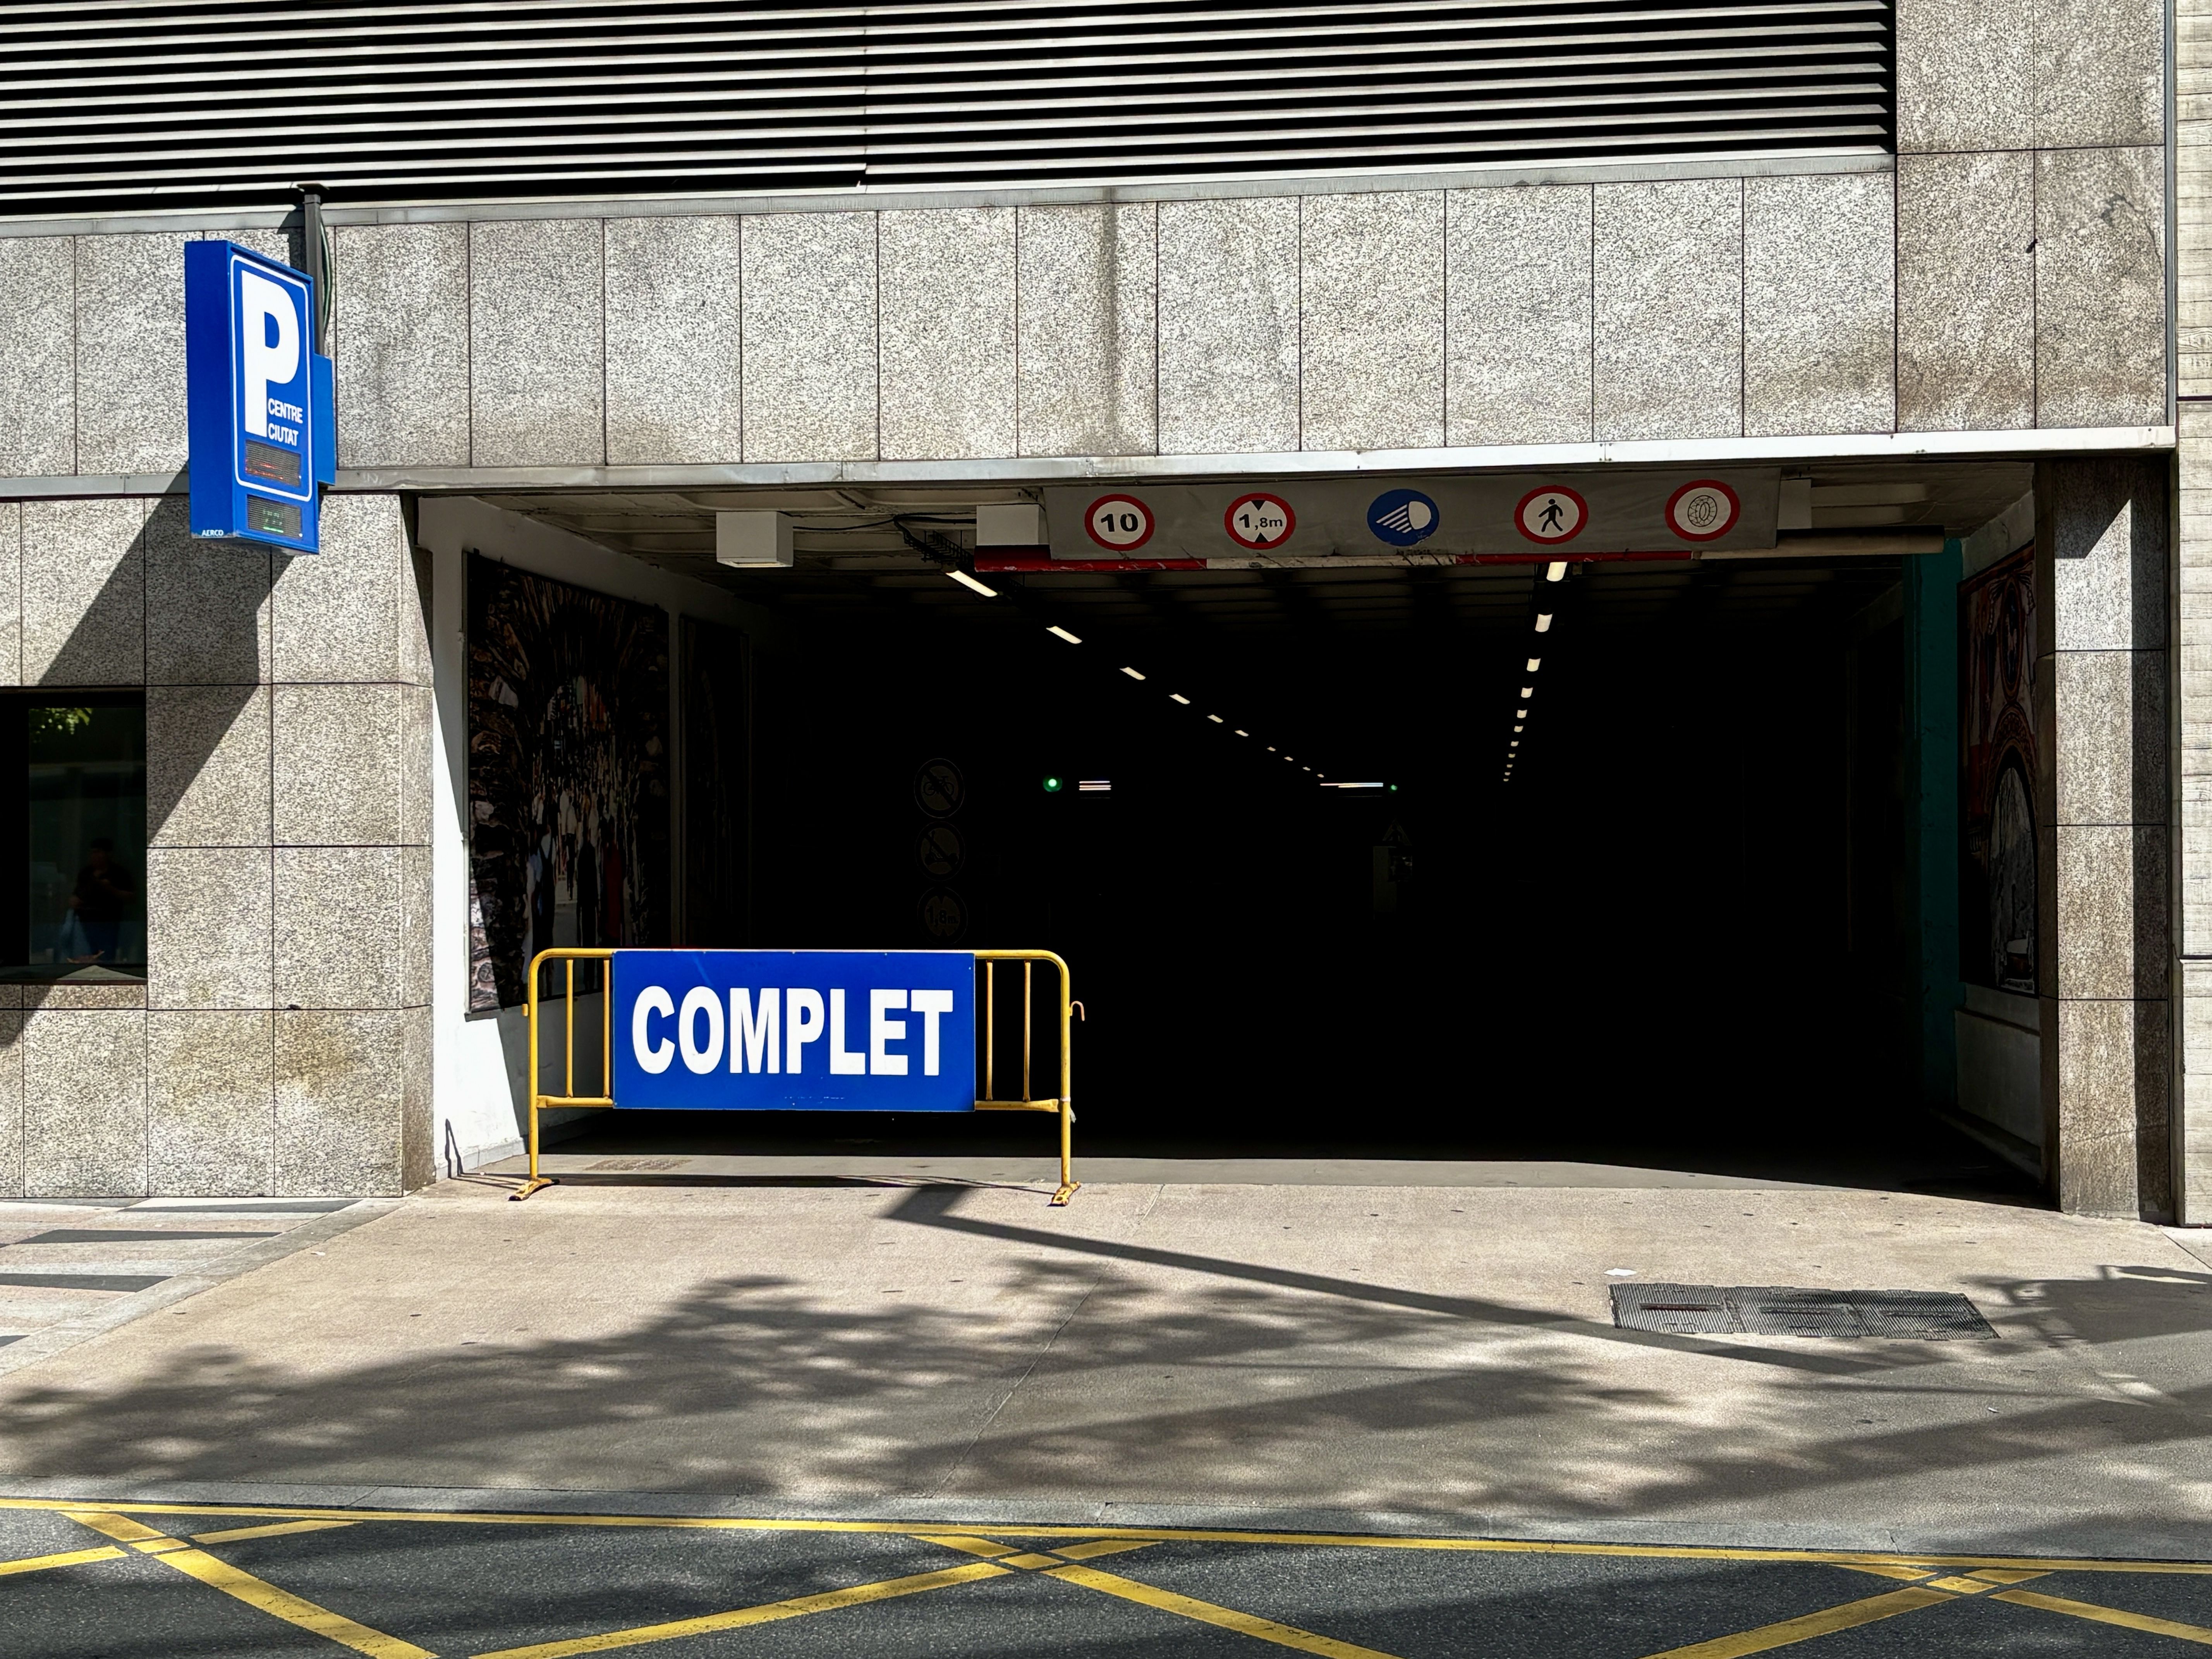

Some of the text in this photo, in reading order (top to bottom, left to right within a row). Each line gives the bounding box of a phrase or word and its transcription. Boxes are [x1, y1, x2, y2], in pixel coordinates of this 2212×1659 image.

[242, 270, 299, 437] P
[268, 398, 303, 424] CENTRE
[268, 423, 299, 446] CIUTAT
[1101, 513, 1139, 532] 10
[1239, 514, 1283, 530] 1,8m
[632, 985, 953, 1076] COMPLET
